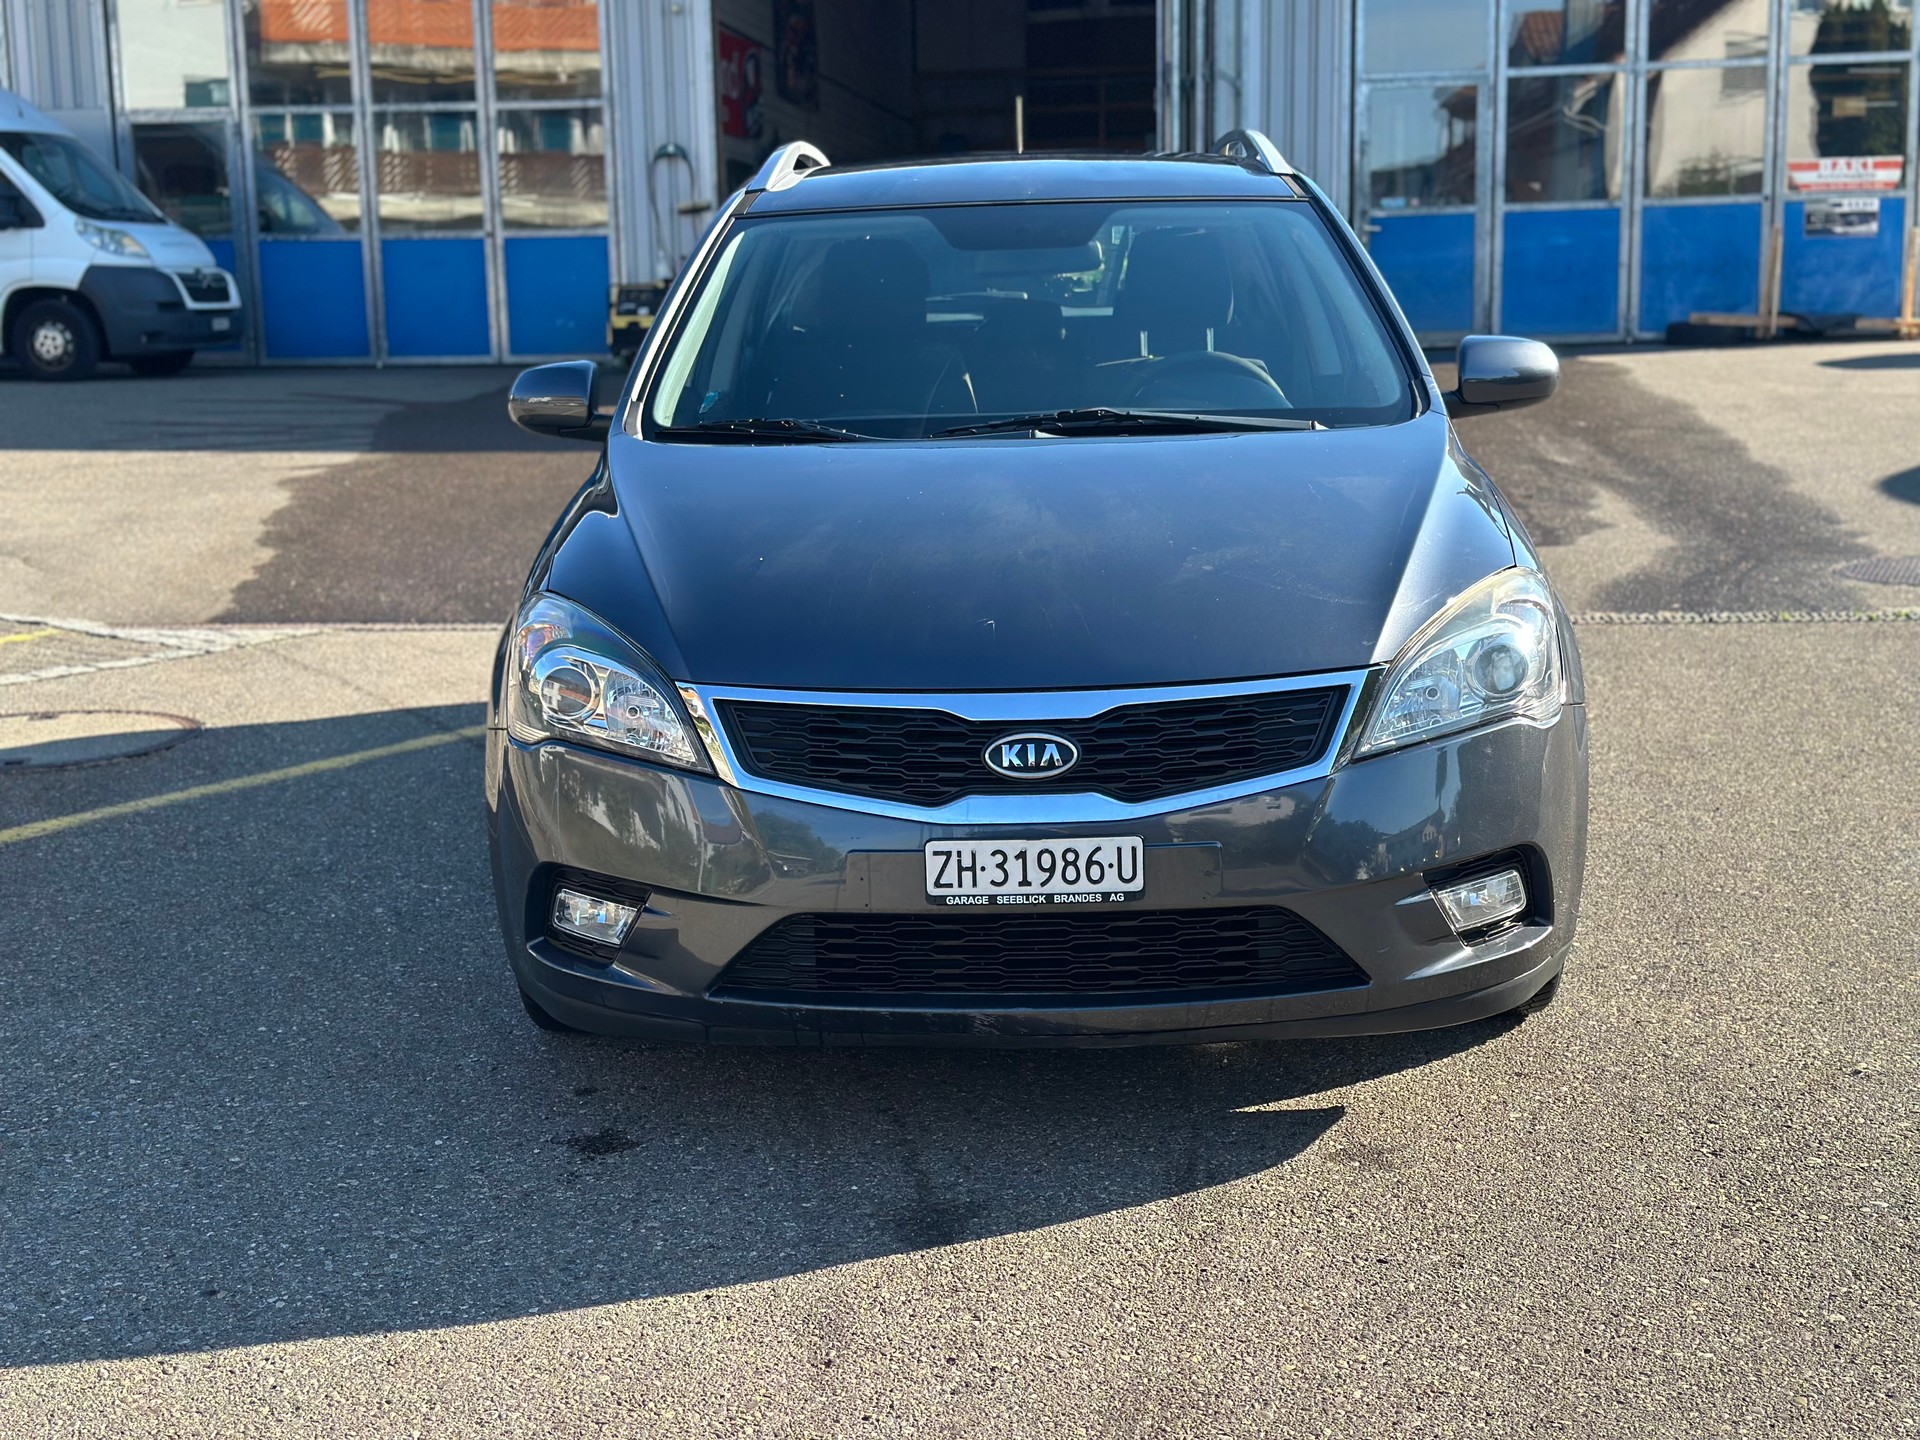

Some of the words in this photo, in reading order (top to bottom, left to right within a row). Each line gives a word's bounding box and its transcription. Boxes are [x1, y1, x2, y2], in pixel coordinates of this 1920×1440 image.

[1001, 743, 1063, 768] KIA
[946, 895, 989, 905] GARAGE
[996, 894, 1046, 904] SEEBLICK
[1053, 893, 1102, 903] BRANDES
[1109, 892, 1125, 902] AG
